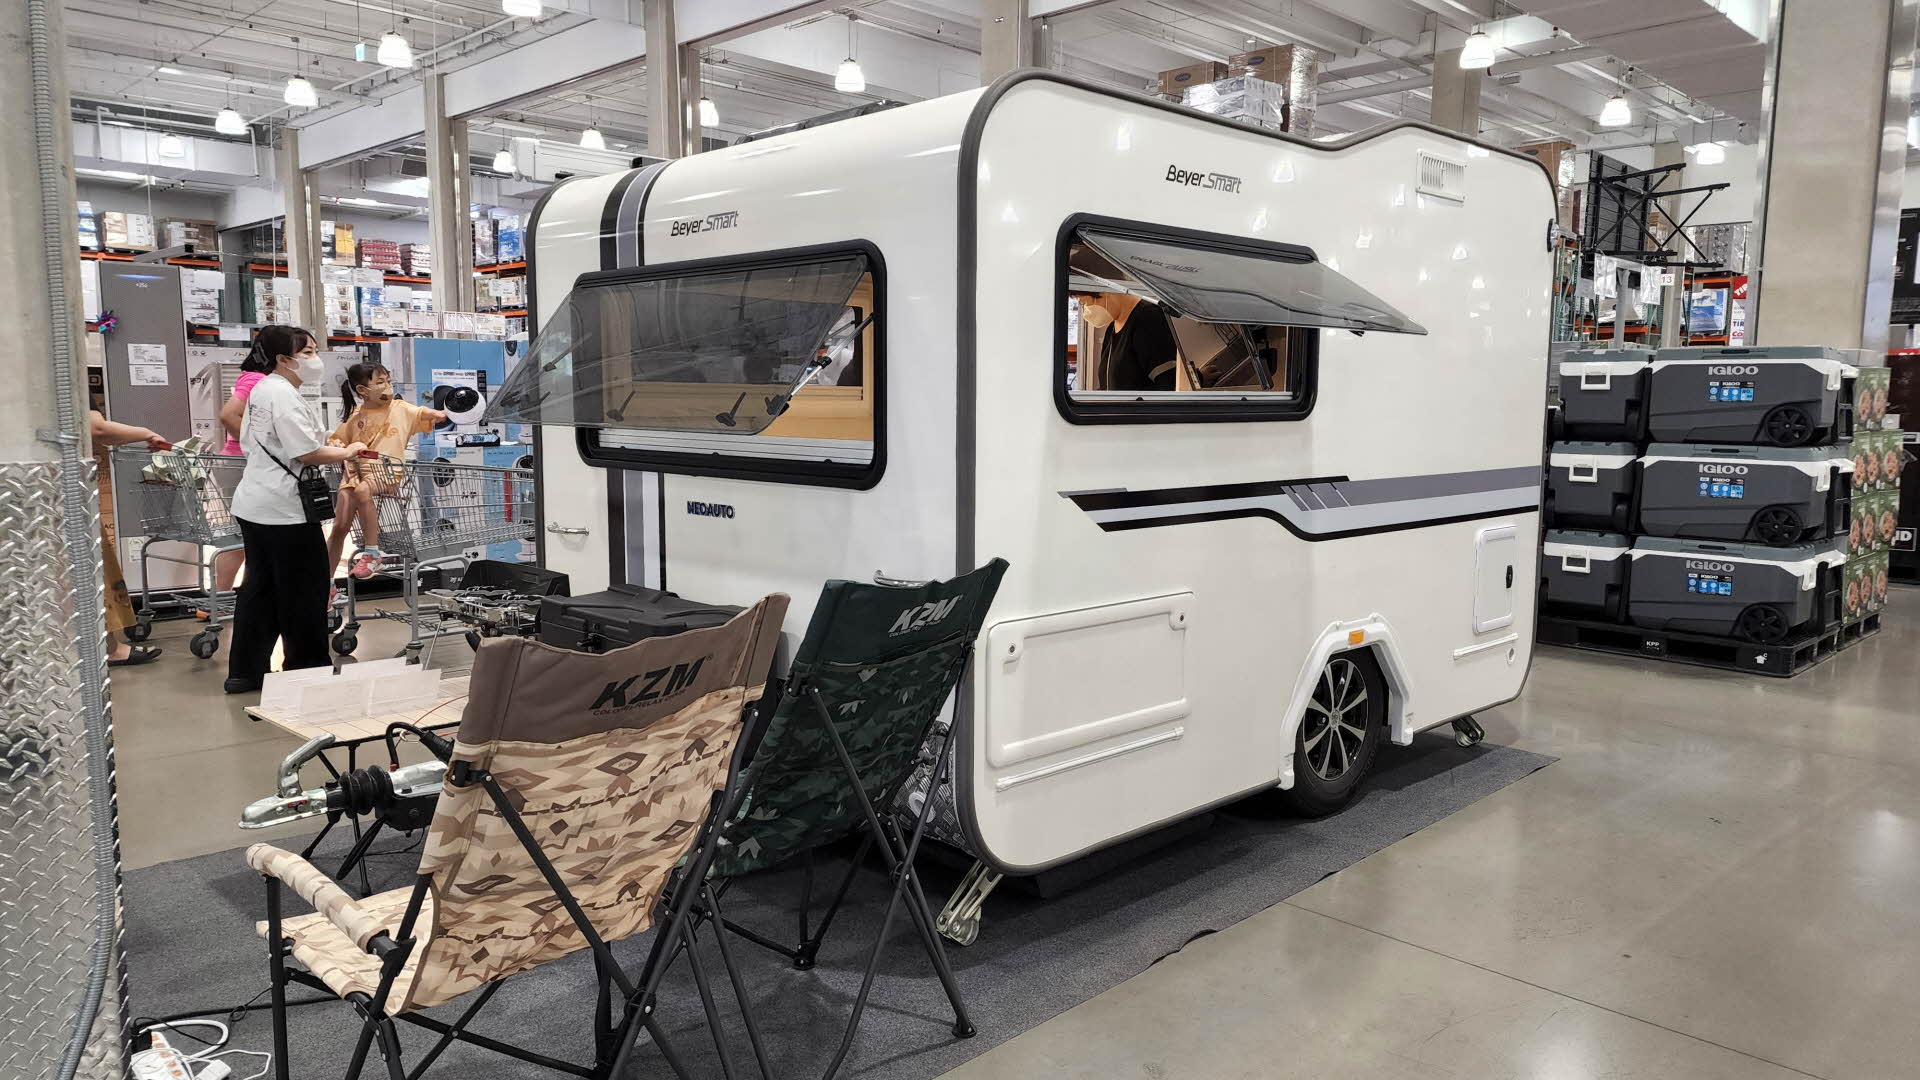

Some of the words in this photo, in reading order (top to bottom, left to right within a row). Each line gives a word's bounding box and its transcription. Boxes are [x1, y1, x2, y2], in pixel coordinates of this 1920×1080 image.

[1166, 165, 1205, 187] Beyer
[1203, 172, 1242, 194] Smart
[671, 220, 703, 236] Beyer
[702, 211, 739, 232] Smart
[1708, 366, 1759, 375] IGLOO
[1699, 464, 1749, 475] IGLOO
[687, 501, 735, 519] NEOAUTO
[1686, 560, 1735, 572] IGLOO
[887, 595, 960, 633] KZM
[589, 656, 706, 710] KZM
